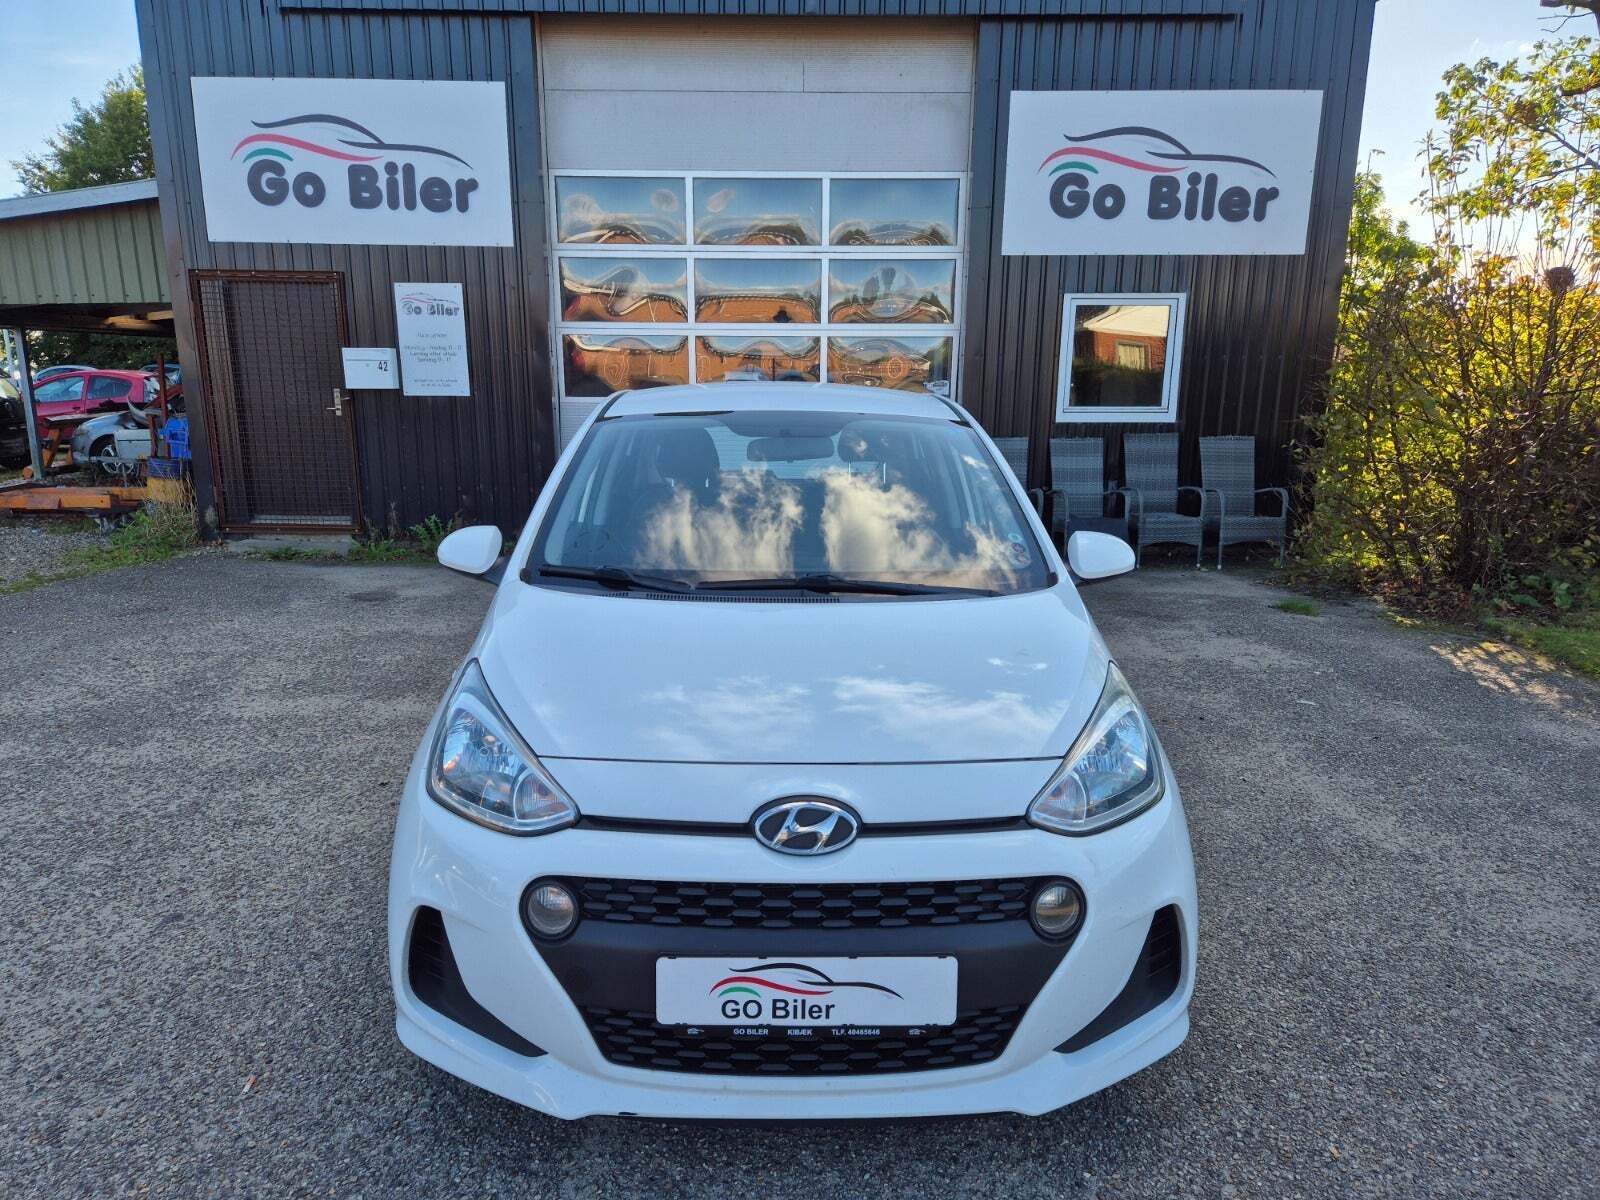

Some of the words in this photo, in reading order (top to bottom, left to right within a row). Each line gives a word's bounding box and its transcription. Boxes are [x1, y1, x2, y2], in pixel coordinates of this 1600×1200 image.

[247, 159, 326, 208] Go
[347, 161, 479, 213] Biler
[1049, 172, 1126, 220] Go
[1147, 171, 1280, 222] Biler
[427, 303, 460, 317] Biler
[377, 361, 388, 372] 42
[721, 999, 763, 1020] GO
[772, 998, 835, 1020] Biler
[733, 1028, 745, 1036] GO
[746, 1028, 769, 1036] BILER
